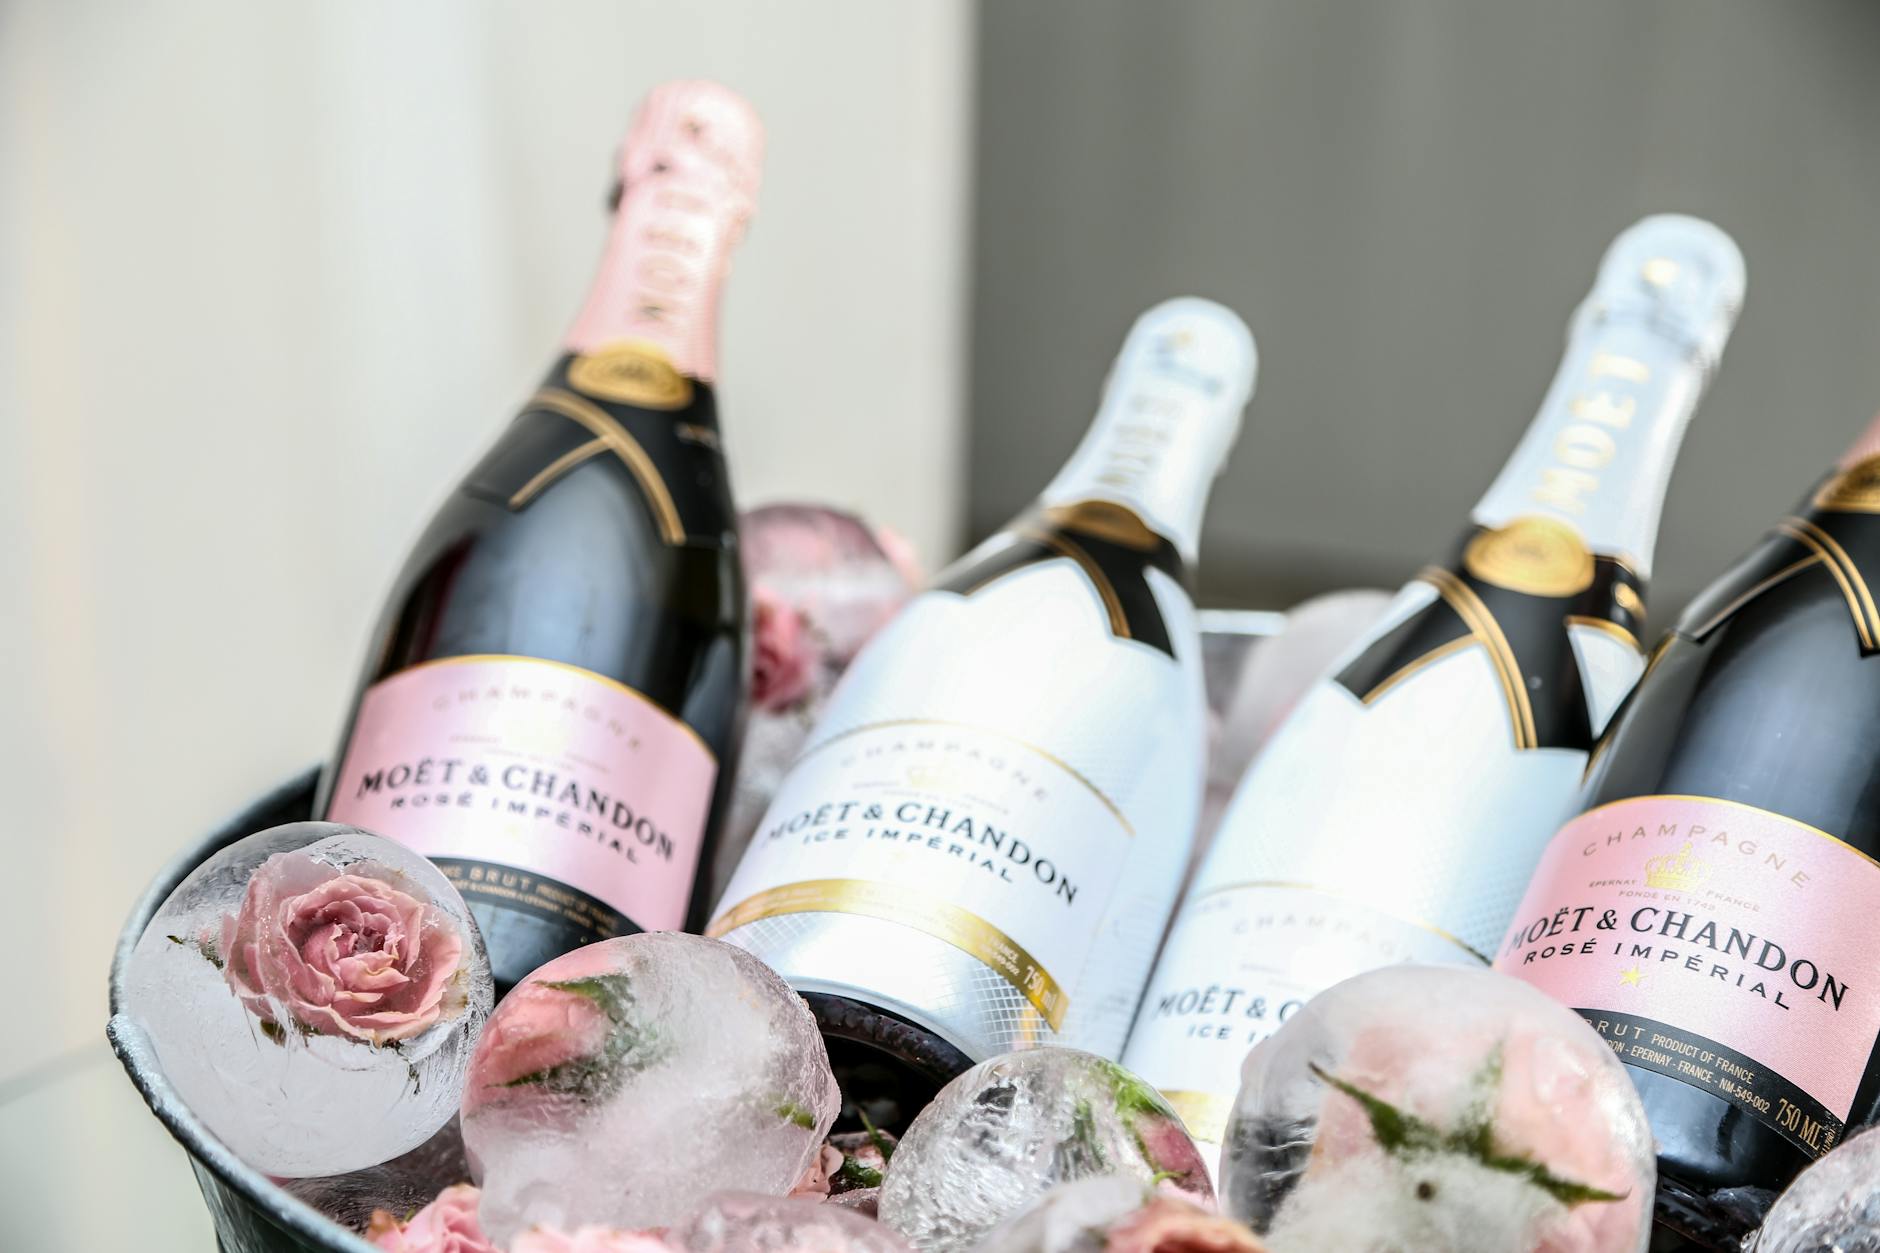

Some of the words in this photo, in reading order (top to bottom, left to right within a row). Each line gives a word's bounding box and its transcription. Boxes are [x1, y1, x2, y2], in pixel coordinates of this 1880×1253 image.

[468, 764, 488, 786] &
[502, 762, 675, 863] CHANDON
[469, 865, 532, 890] BRUT
[803, 828, 849, 845] ICE
[866, 828, 1015, 884] IMPÉRIAL
[862, 803, 883, 821] &
[896, 802, 1079, 907] CHANDON
[1583, 823, 1811, 889] CHAMPAGNE
[1505, 906, 1594, 957] MOËT
[1596, 909, 1617, 930] &
[1630, 906, 1849, 1012] CHANDON
[1523, 938, 1597, 965] ROSÉ
[1613, 941, 1790, 1011] IMPÉRIAL
[1187, 1023, 1232, 1039] ICE
[1246, 997, 1267, 1019] &
[1630, 1045, 1673, 1067] EPERNAY
[1677, 1060, 1714, 1084] FRANCE
[1719, 1077, 1771, 1114] NM-549-002
[1651, 1033, 1700, 1059] PRODUCT
[1700, 1050, 1716, 1066] OF
[1715, 1057, 1755, 1085] FRANCE
[1775, 1097, 1801, 1132] 750
